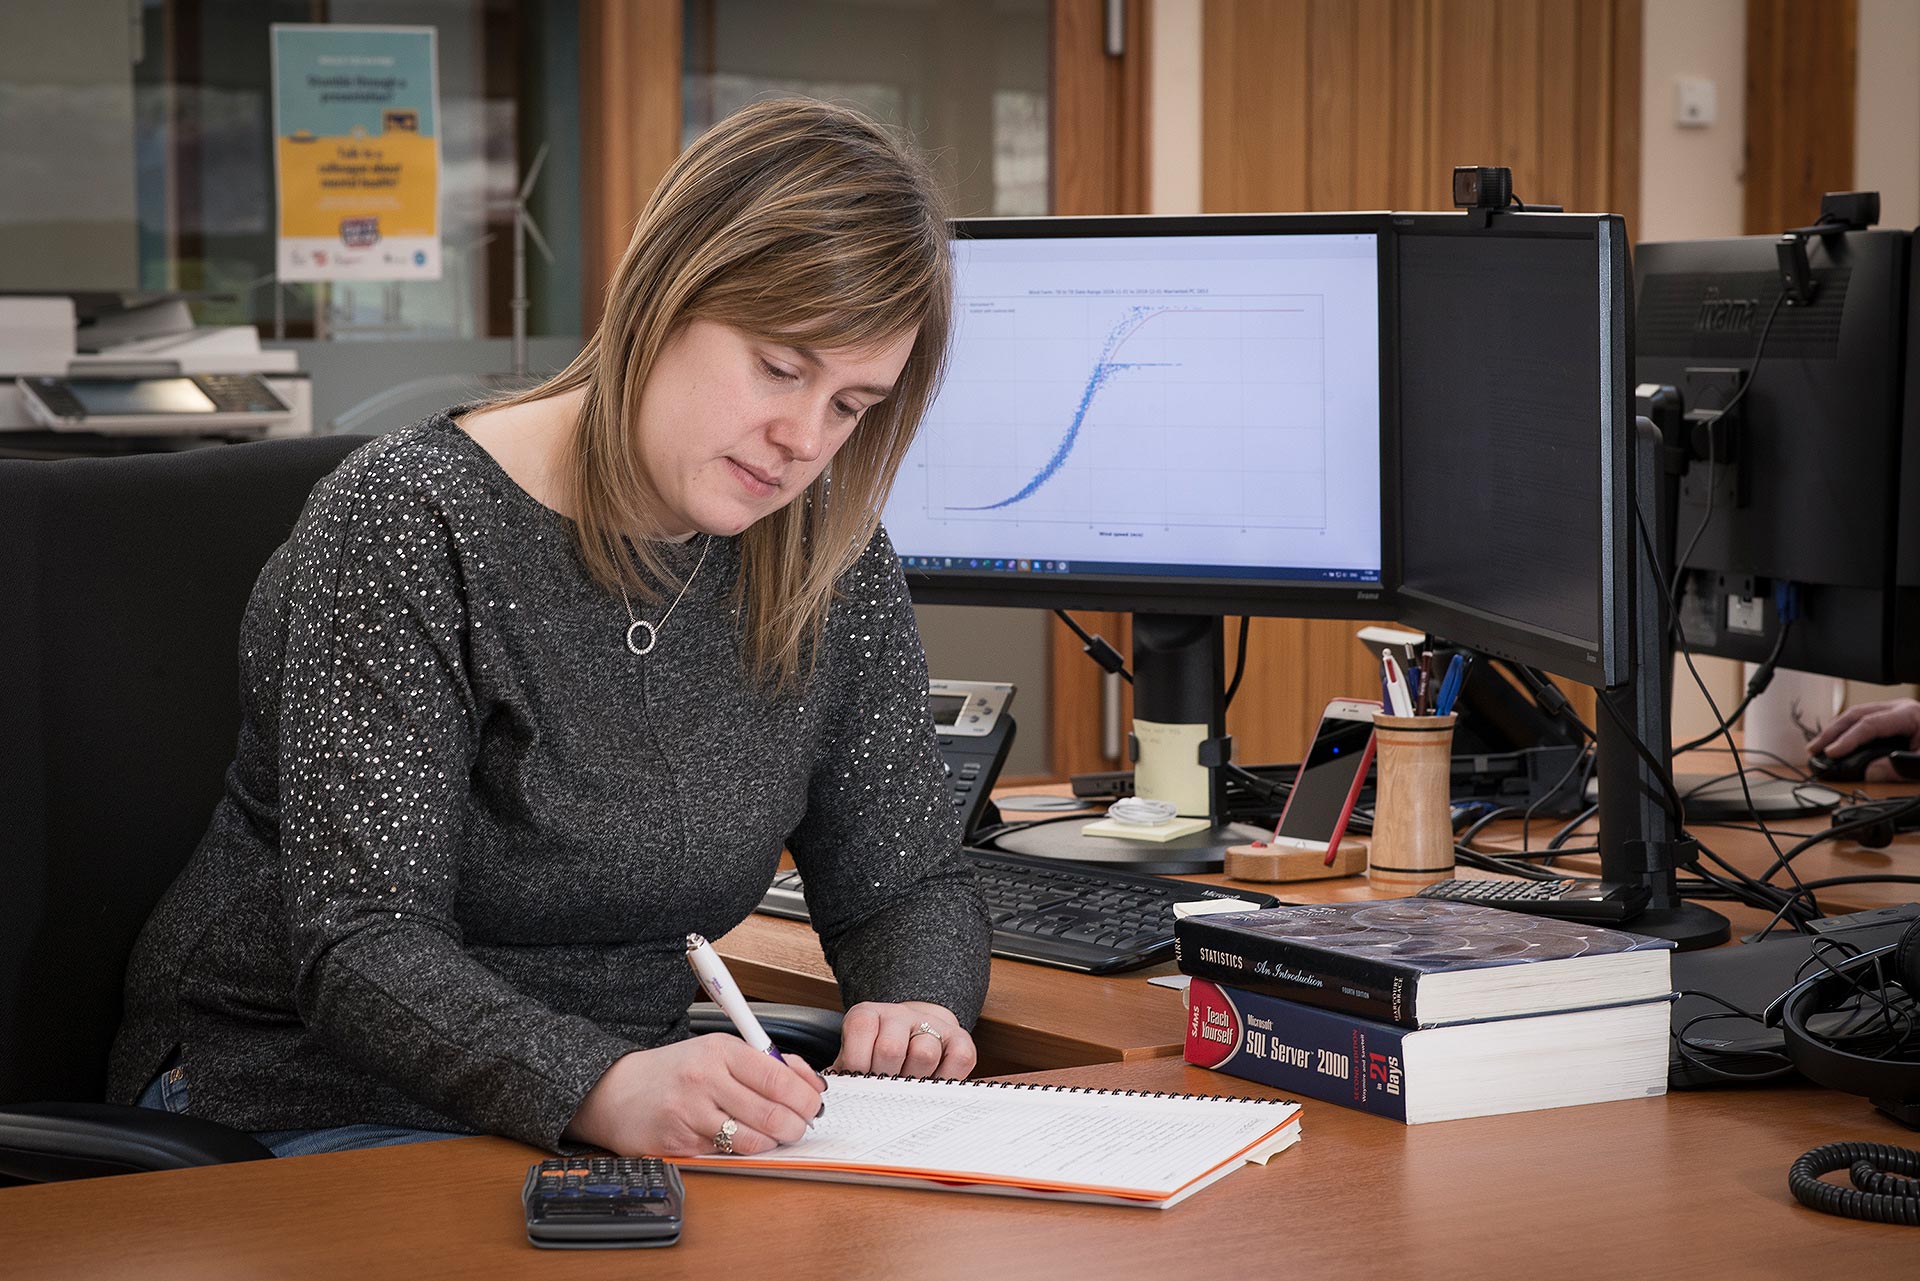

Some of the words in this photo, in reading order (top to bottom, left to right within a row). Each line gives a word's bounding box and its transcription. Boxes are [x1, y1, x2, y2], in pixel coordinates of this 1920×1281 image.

[1200, 889, 1241, 899] Microsoft
[1174, 937, 1183, 961] KIRK
[1200, 947, 1243, 969] STATISTICS
[1254, 960, 1271, 976] An
[1272, 963, 1324, 988] Introduction
[1392, 975, 1400, 1022] HARCOURT
[1396, 977, 1404, 1004] BRACE
[1191, 1005, 1200, 1037] SAMS
[1206, 1006, 1229, 1028] Teach
[1247, 1013, 1273, 1031] Microsoft
[1201, 1021, 1233, 1045] Yourself
[1246, 1030, 1267, 1059] SQL
[1317, 1048, 1349, 1080] 2000
[1368, 1052, 1388, 1083] 21
[1376, 1082, 1383, 1091] in
[1386, 1056, 1403, 1096] Days
